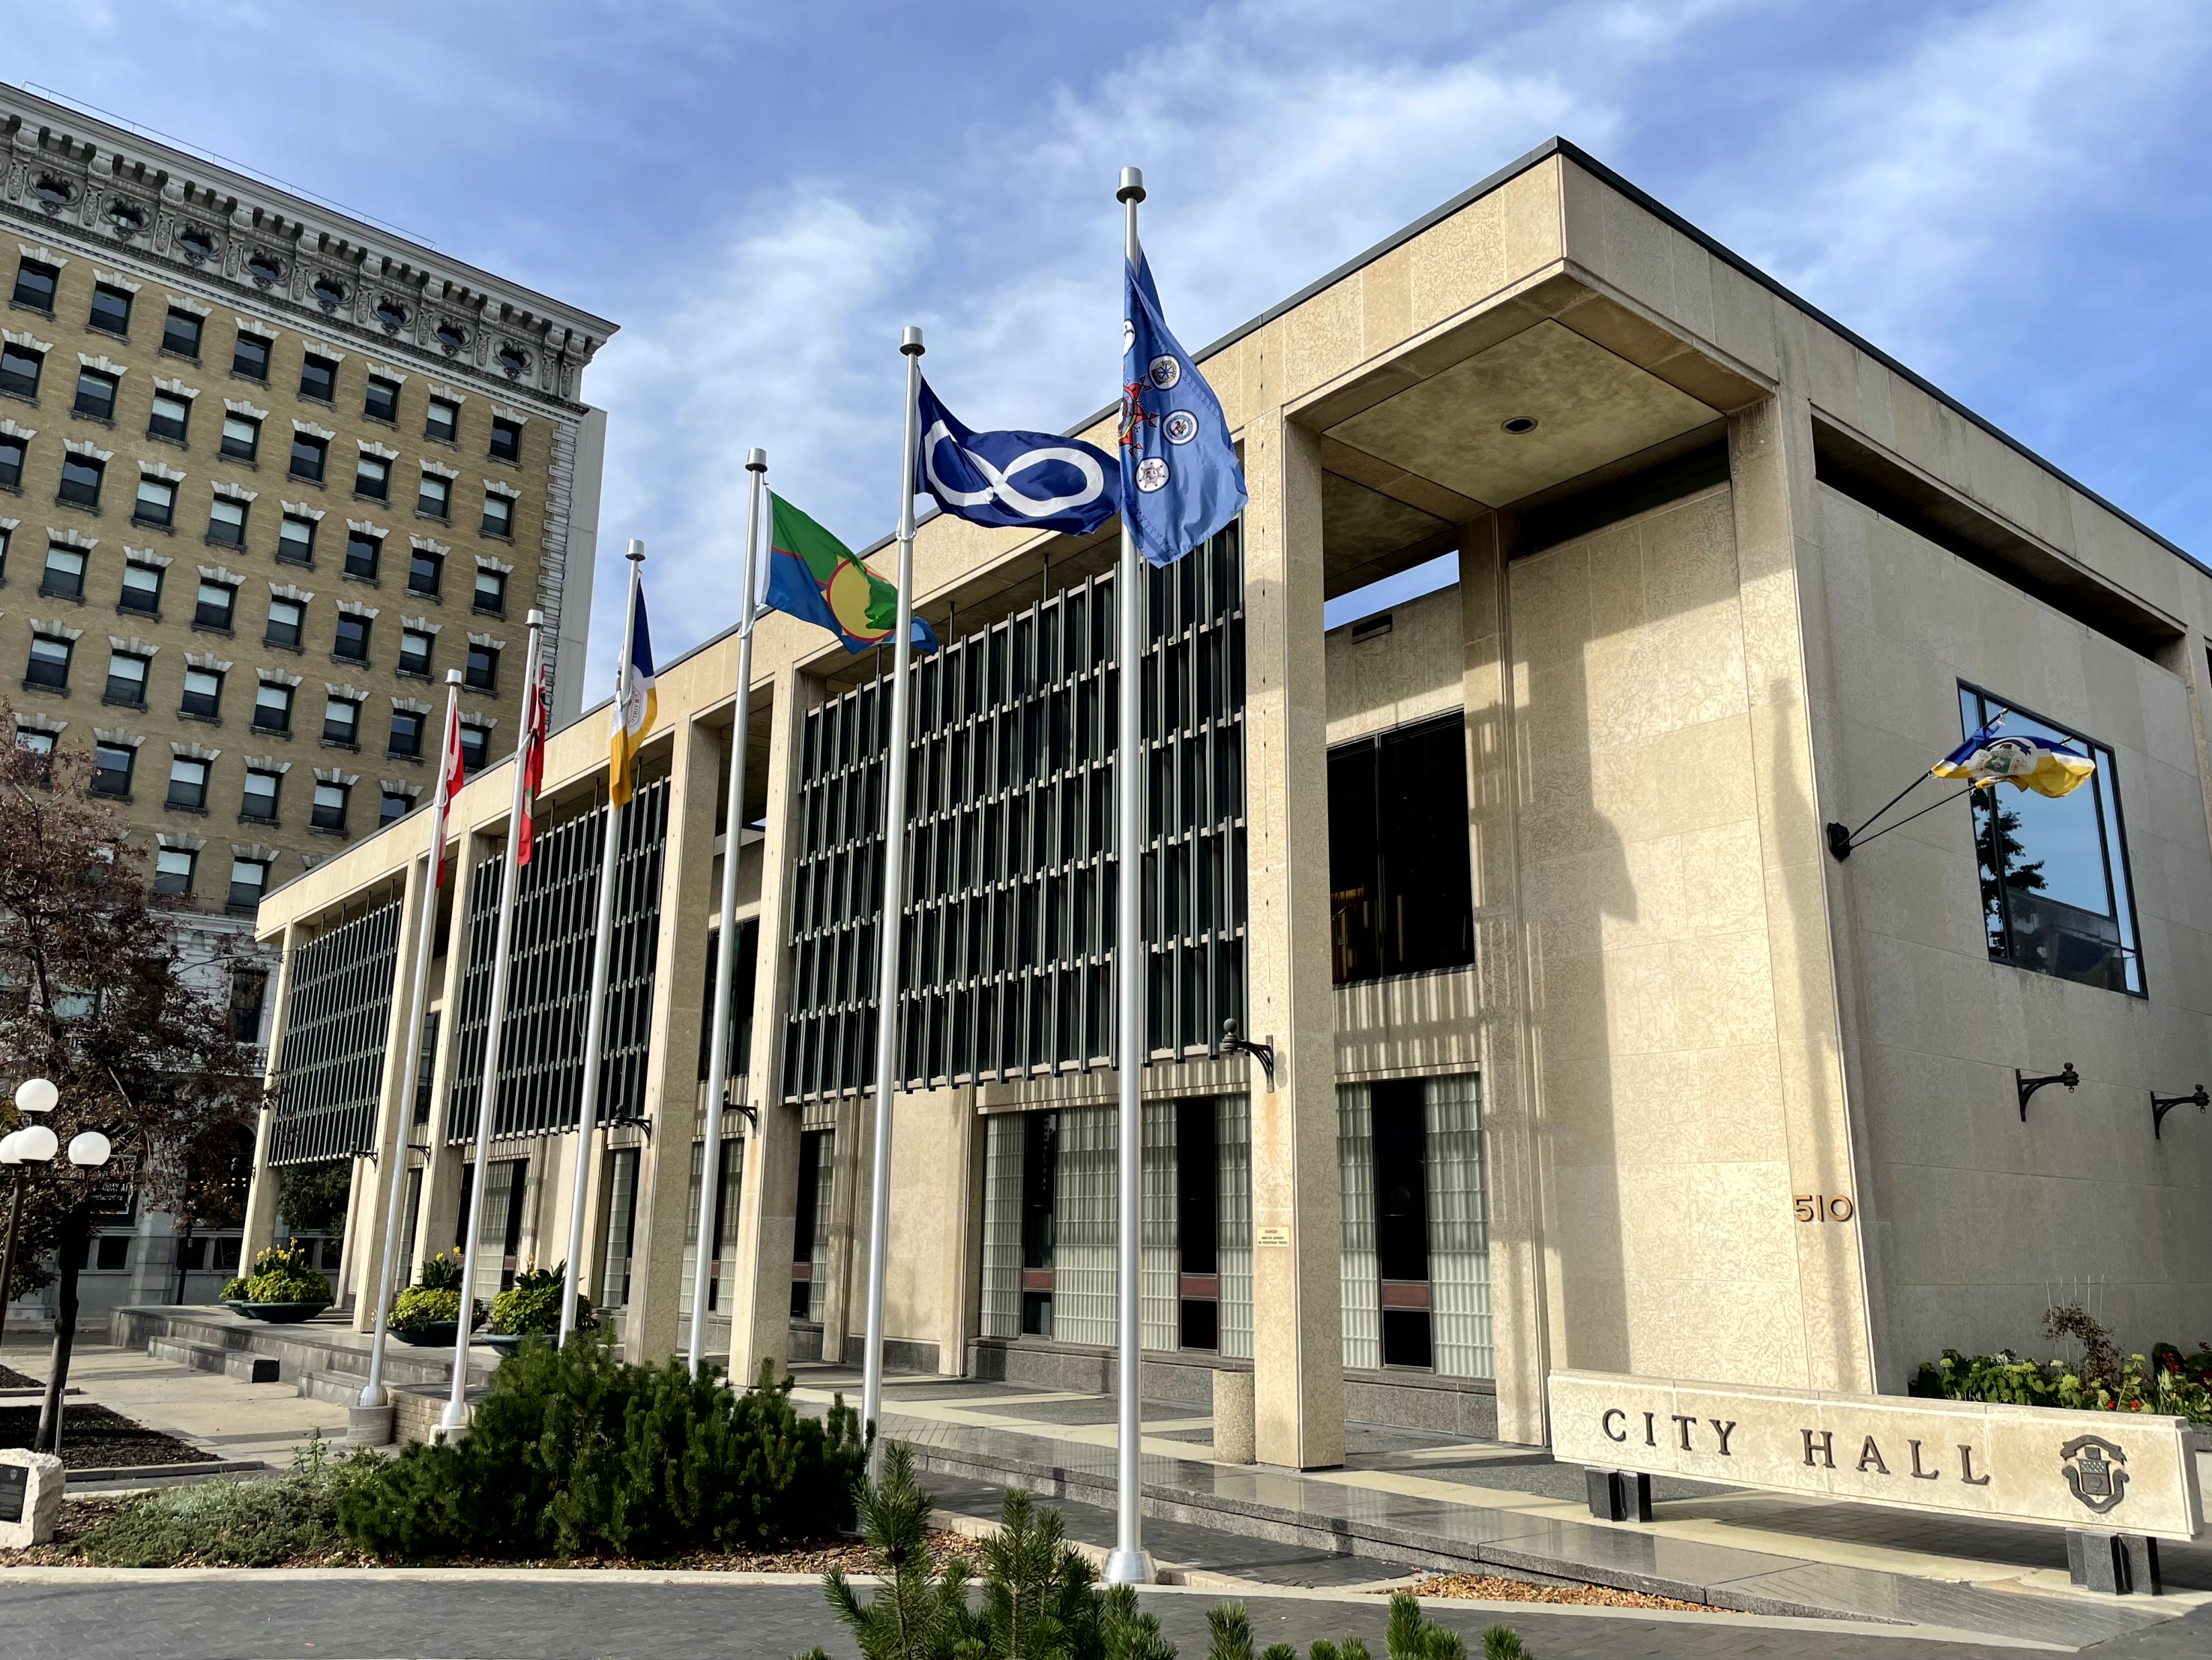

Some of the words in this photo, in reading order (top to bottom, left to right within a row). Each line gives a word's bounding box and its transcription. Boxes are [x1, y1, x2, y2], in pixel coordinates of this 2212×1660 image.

[1792, 1194, 1853, 1222] 510
[1602, 1408, 1737, 1456] CITY
[1800, 1428, 1991, 1486] HALL
